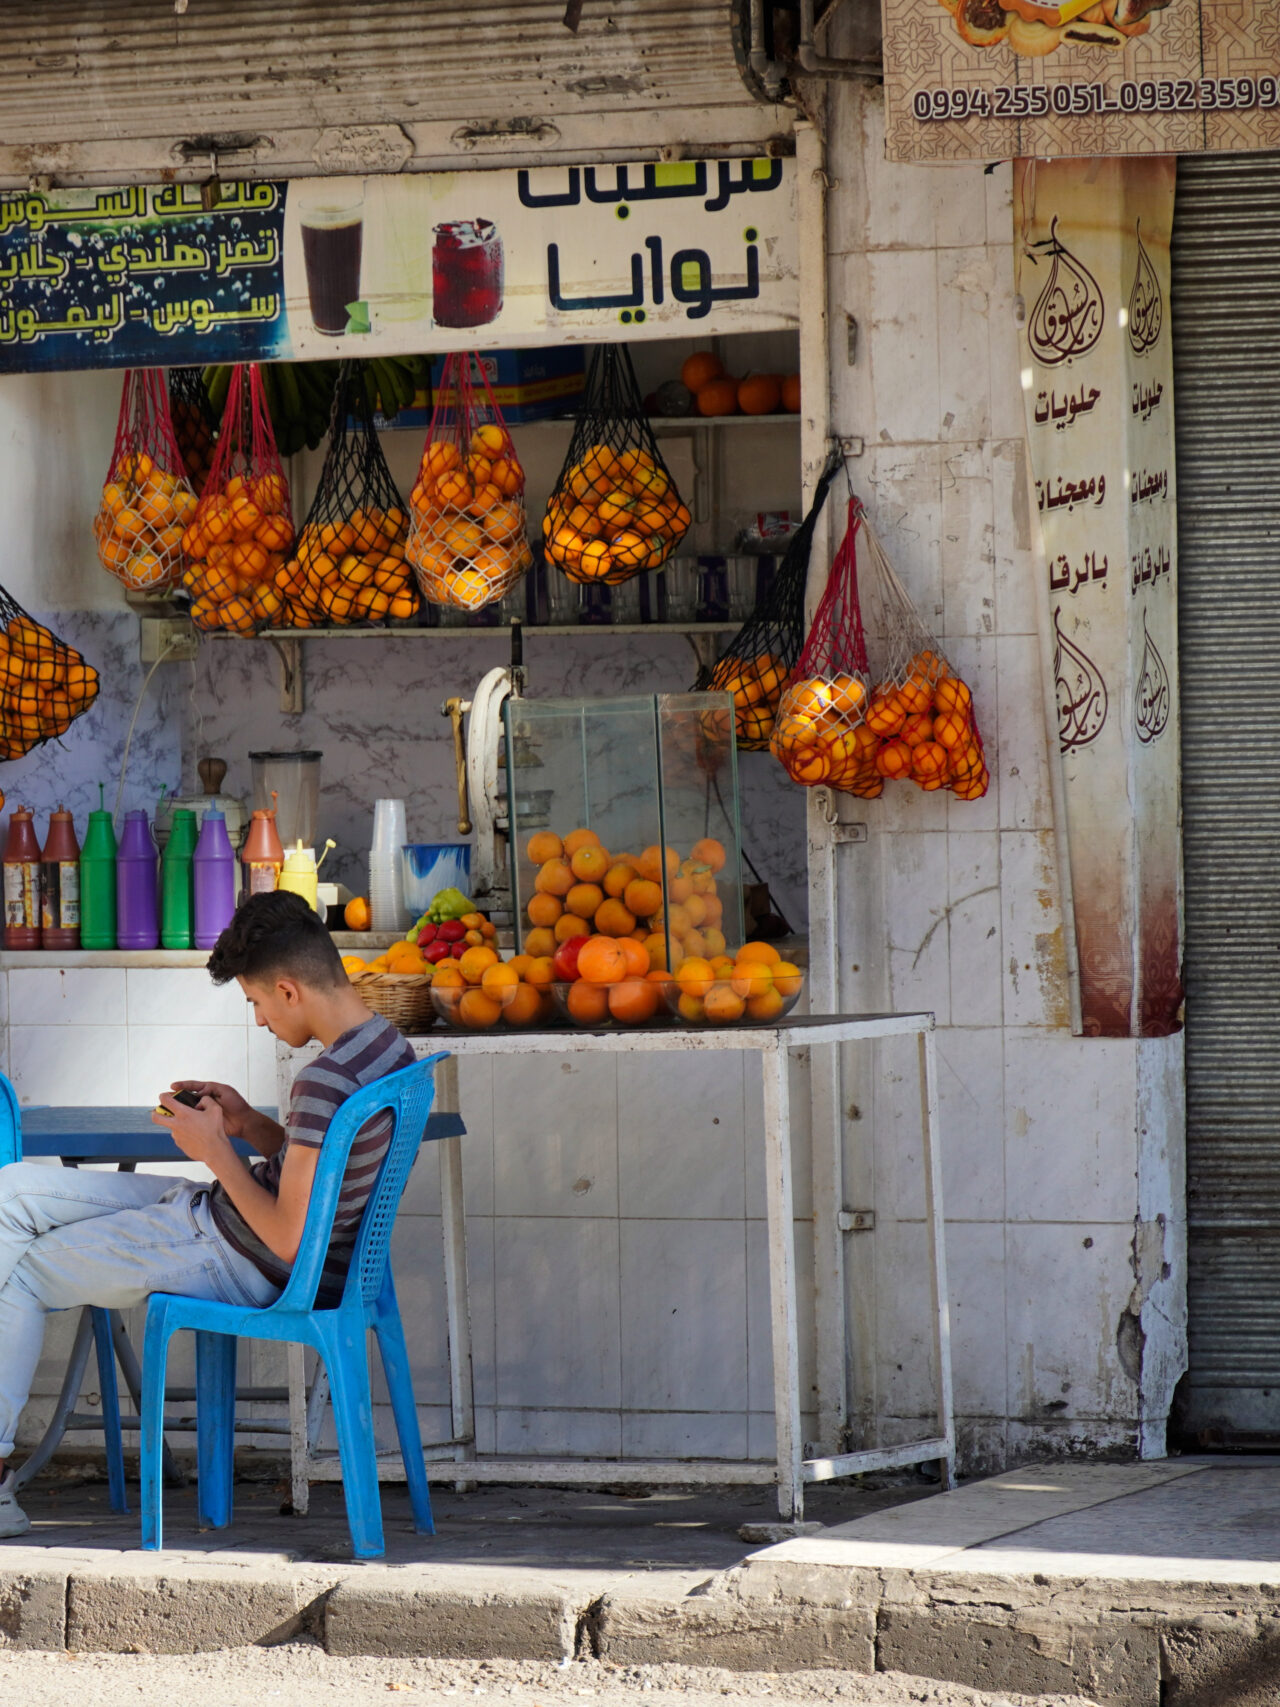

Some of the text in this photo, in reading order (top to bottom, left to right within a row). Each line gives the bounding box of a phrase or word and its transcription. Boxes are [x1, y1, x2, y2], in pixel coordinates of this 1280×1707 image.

[913, 88, 989, 119] 0994
[994, 85, 1047, 116] 255
[1199, 77, 1254, 109] 359
[1257, 76, 1280, 107] 9
[98, 236, 205, 285] هندي
[215, 227, 275, 275] تمر
[547, 227, 760, 322] نوايا
[152, 294, 275, 333] سوس
[1034, 383, 1101, 430] حلويات
[1132, 377, 1164, 422] حلويات
[1050, 551, 1108, 594] بالرقا
